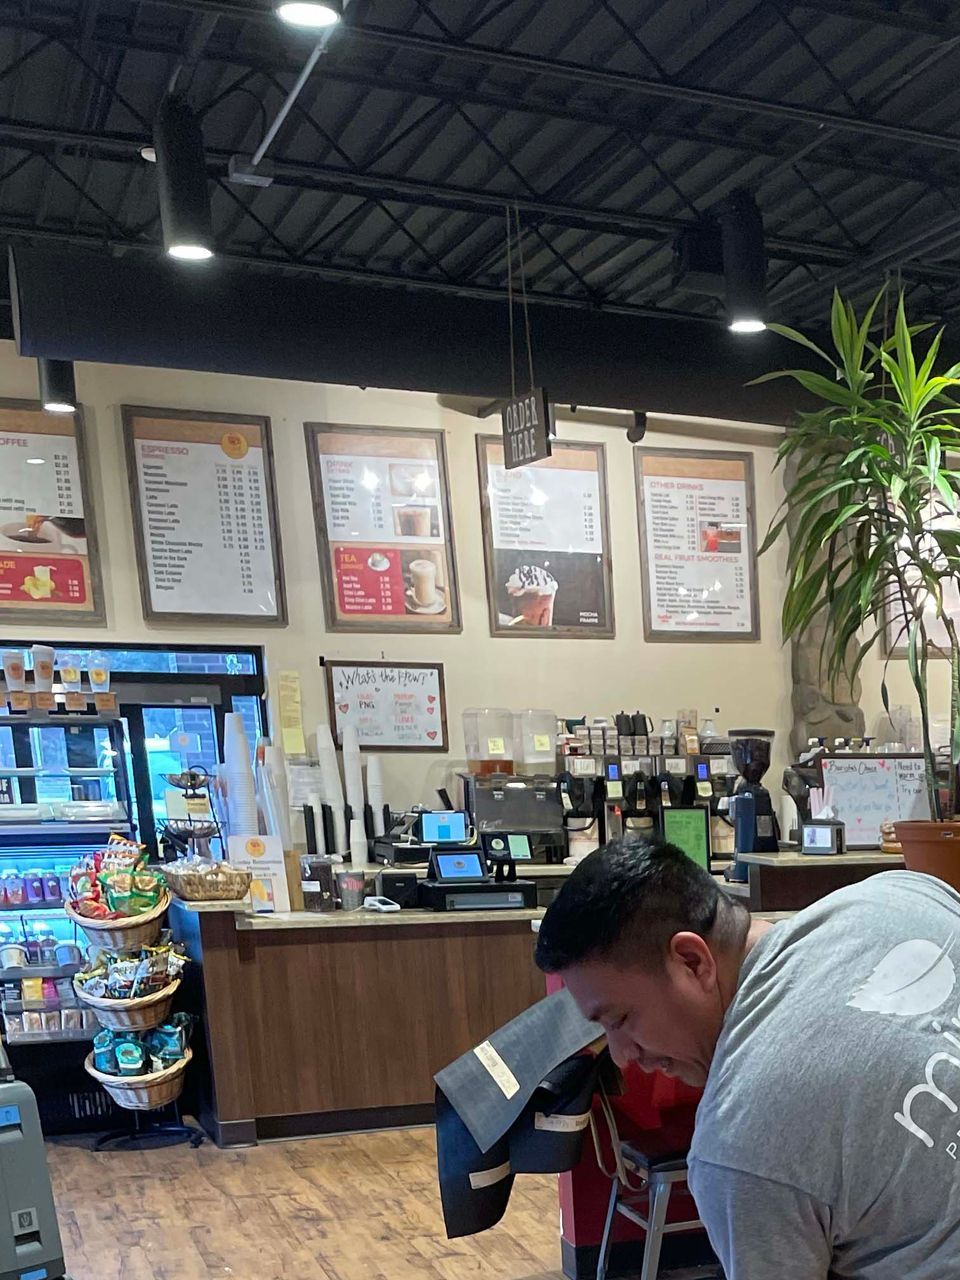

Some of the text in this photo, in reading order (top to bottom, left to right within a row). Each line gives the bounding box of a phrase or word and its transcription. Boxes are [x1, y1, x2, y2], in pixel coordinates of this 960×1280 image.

[506, 396, 538, 433] ORDER
[511, 428, 536, 462] HERE
[340, 554, 358, 562] TEA
